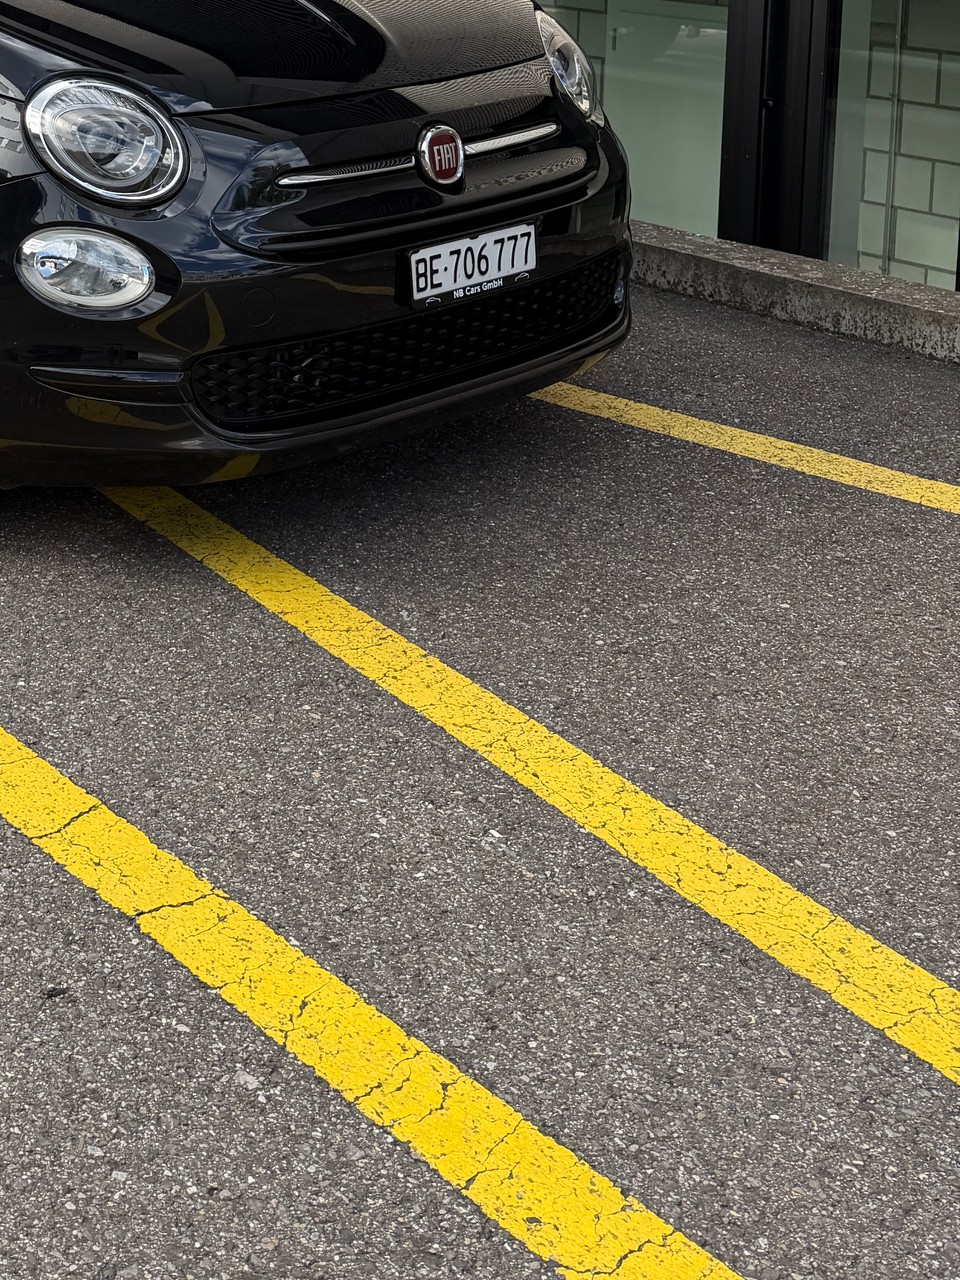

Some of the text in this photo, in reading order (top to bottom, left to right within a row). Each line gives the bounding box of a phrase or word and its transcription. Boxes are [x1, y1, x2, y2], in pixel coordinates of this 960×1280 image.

[433, 142, 456, 171] FIAT
[453, 278, 504, 299] NB Cars GmbH
